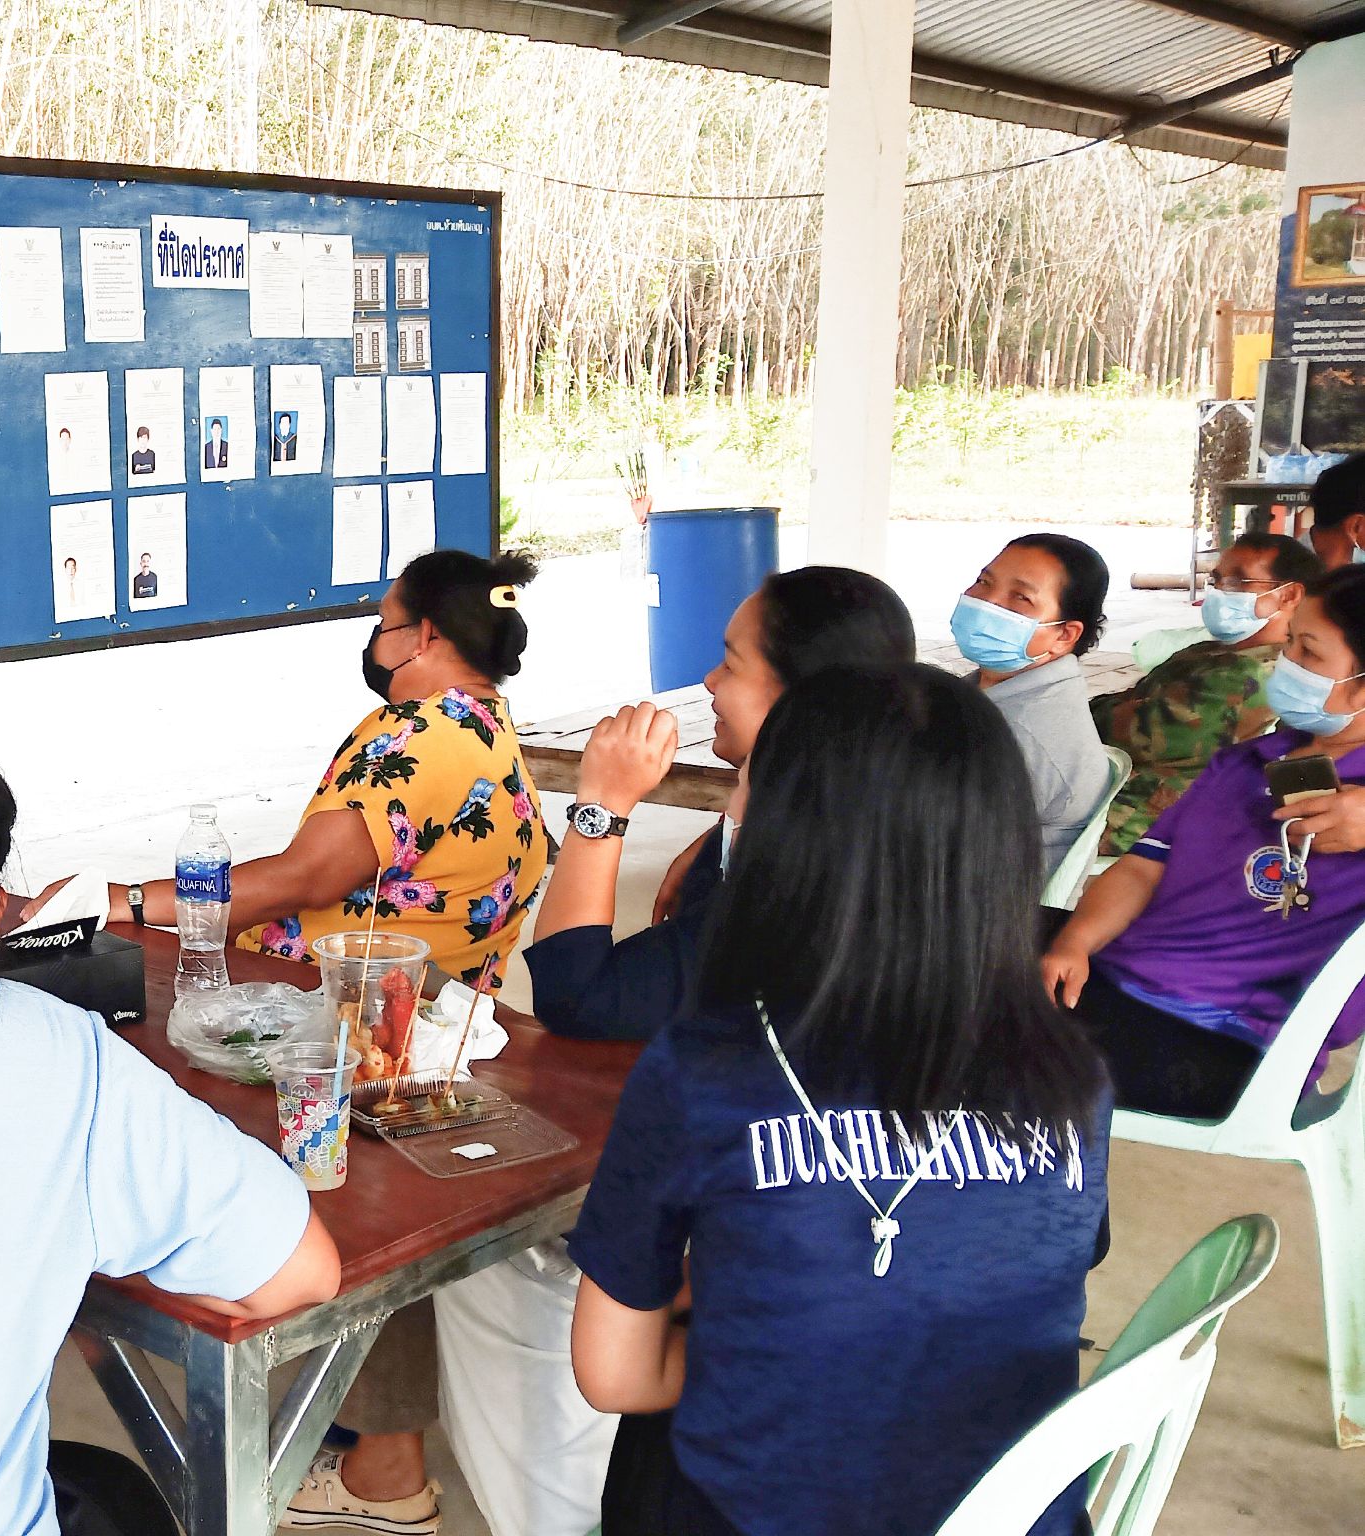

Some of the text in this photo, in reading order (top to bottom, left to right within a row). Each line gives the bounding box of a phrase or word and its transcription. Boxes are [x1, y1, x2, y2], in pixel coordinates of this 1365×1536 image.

[158, 222, 244, 278] ที่ปิดประกาศ
[14, 925, 84, 948] Kleenex
